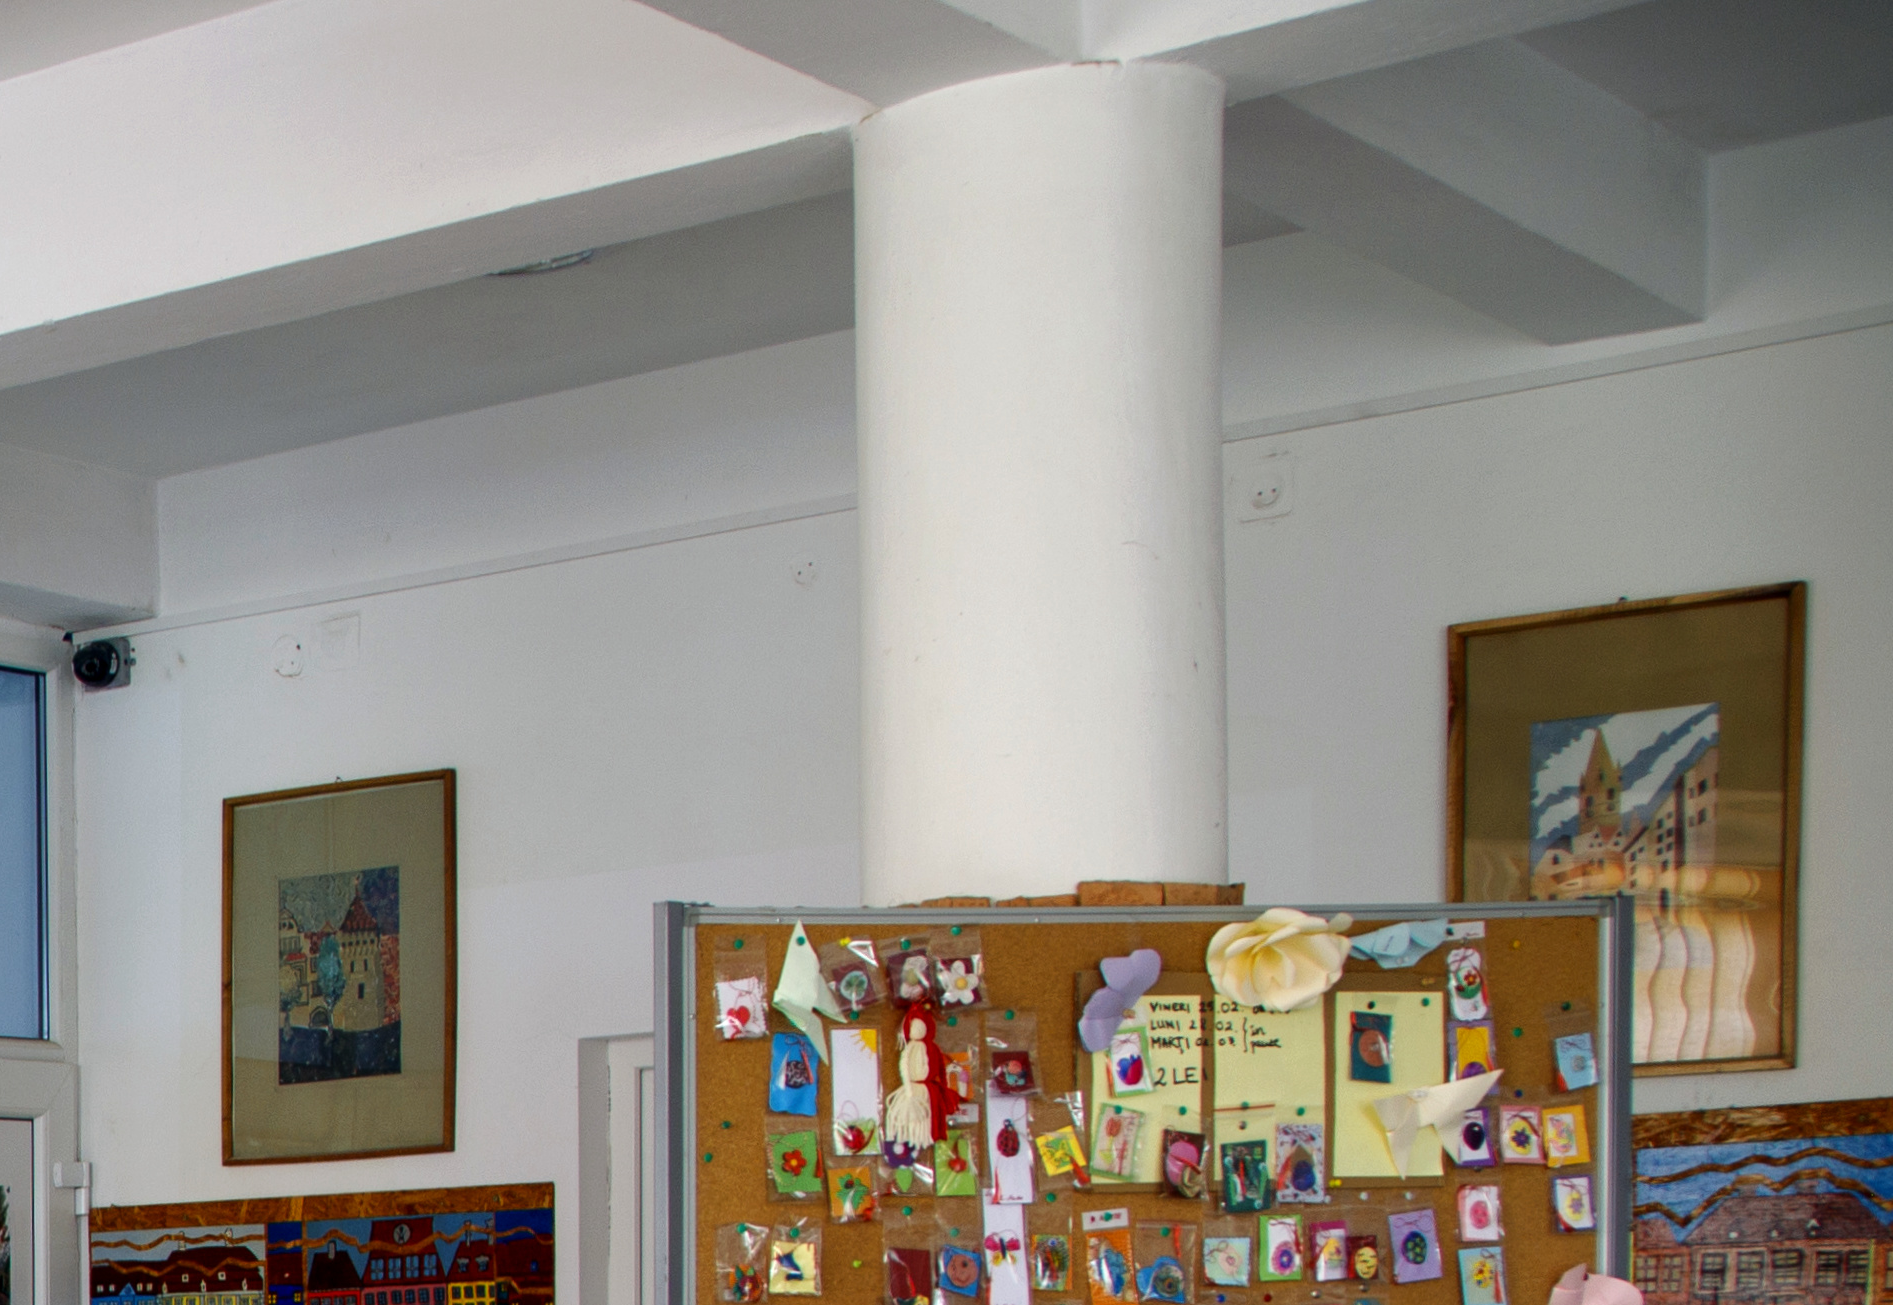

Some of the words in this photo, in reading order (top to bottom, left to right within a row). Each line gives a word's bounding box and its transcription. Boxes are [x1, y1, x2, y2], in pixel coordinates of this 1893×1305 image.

[1150, 1002, 1190, 1013] VINERI
[1150, 1019, 1180, 1031] LUNI
[1154, 1068, 1167, 1086] 2
